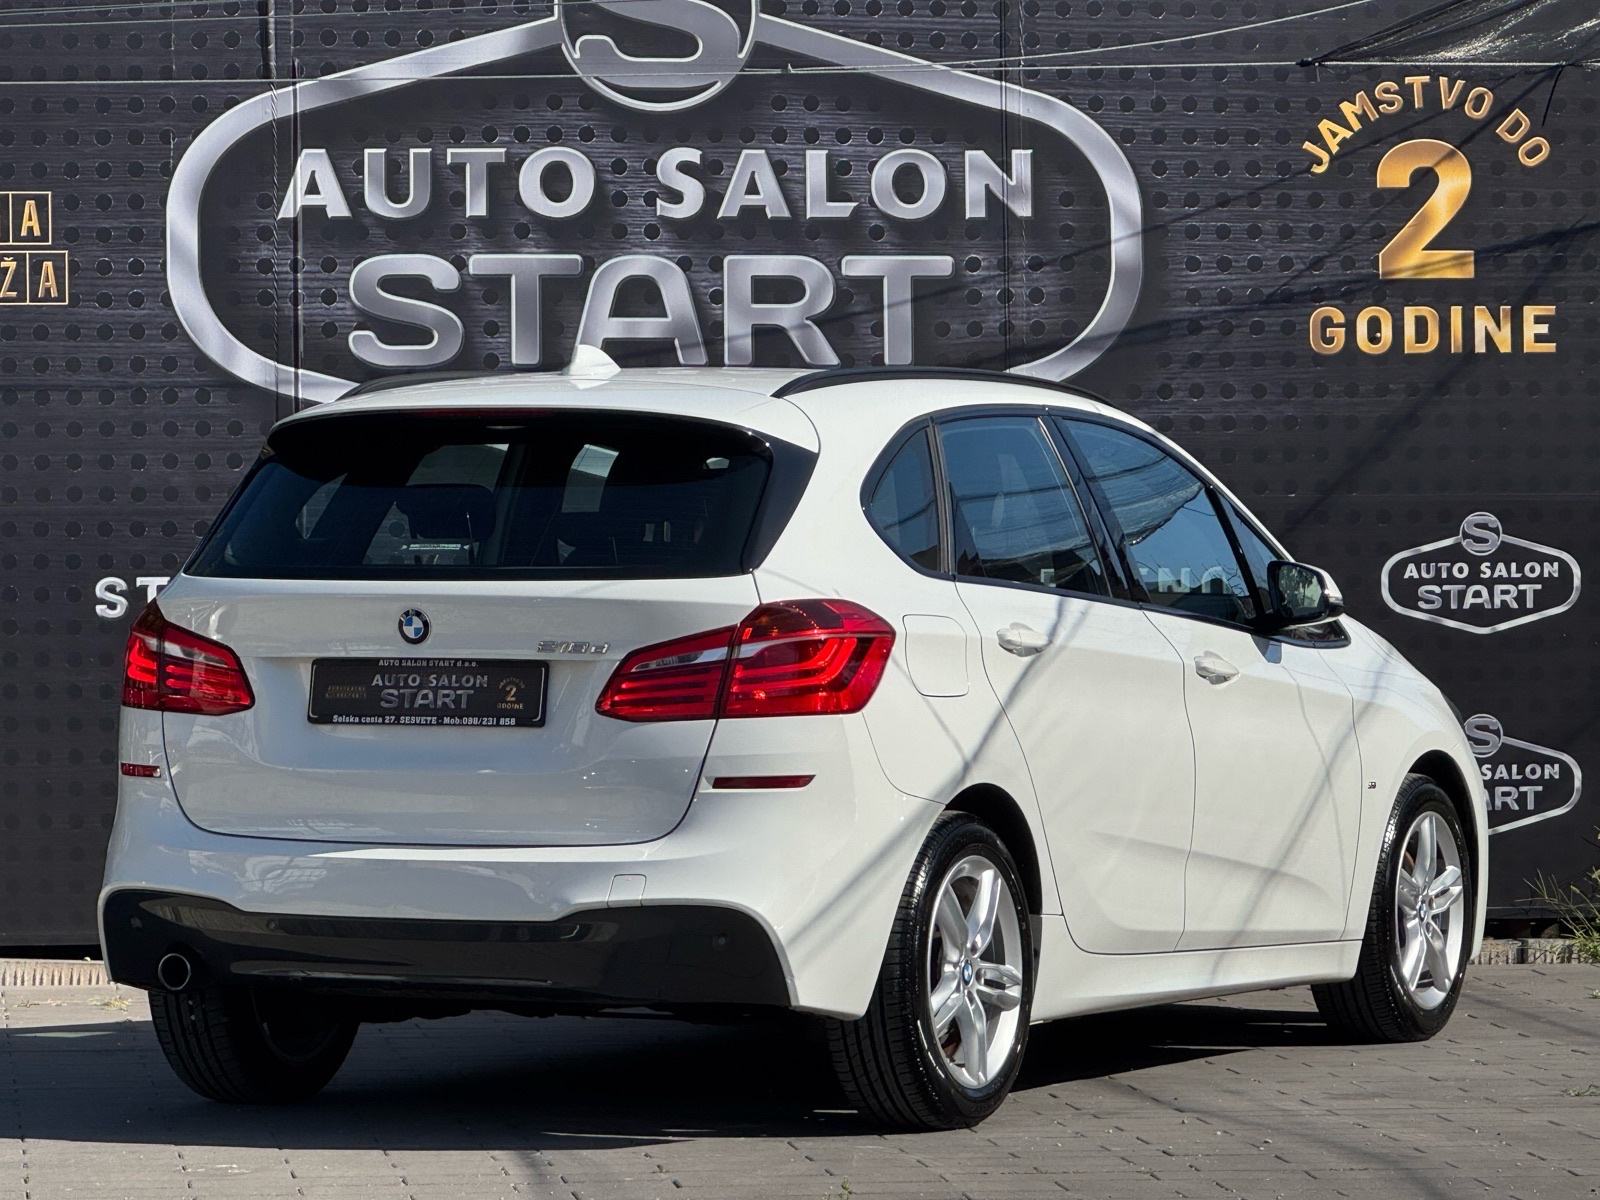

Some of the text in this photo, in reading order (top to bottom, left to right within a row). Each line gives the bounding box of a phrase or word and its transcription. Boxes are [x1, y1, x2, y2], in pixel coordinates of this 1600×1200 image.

[1302, 76, 1551, 174] JAMSTVO DO
[276, 145, 1034, 220] AUTO SALON
[1376, 138, 1475, 280] 2
[348, 253, 955, 368] START
[1309, 305, 1557, 355] GODINE
[1403, 561, 1559, 579] AUTO SALON
[1417, 584, 1542, 610] START
[378, 659, 399, 667] AUTO
[401, 659, 427, 667] SALON
[429, 659, 454, 667] START
[371, 673, 420, 687] AUTO
[428, 674, 488, 688] SALON
[380, 688, 474, 709] START
[505, 684, 517, 702] 2
[332, 714, 359, 724] Selska
[361, 715, 383, 724] cesta
[400, 716, 437, 725] SESVETE
[1481, 762, 1560, 780] SALON
